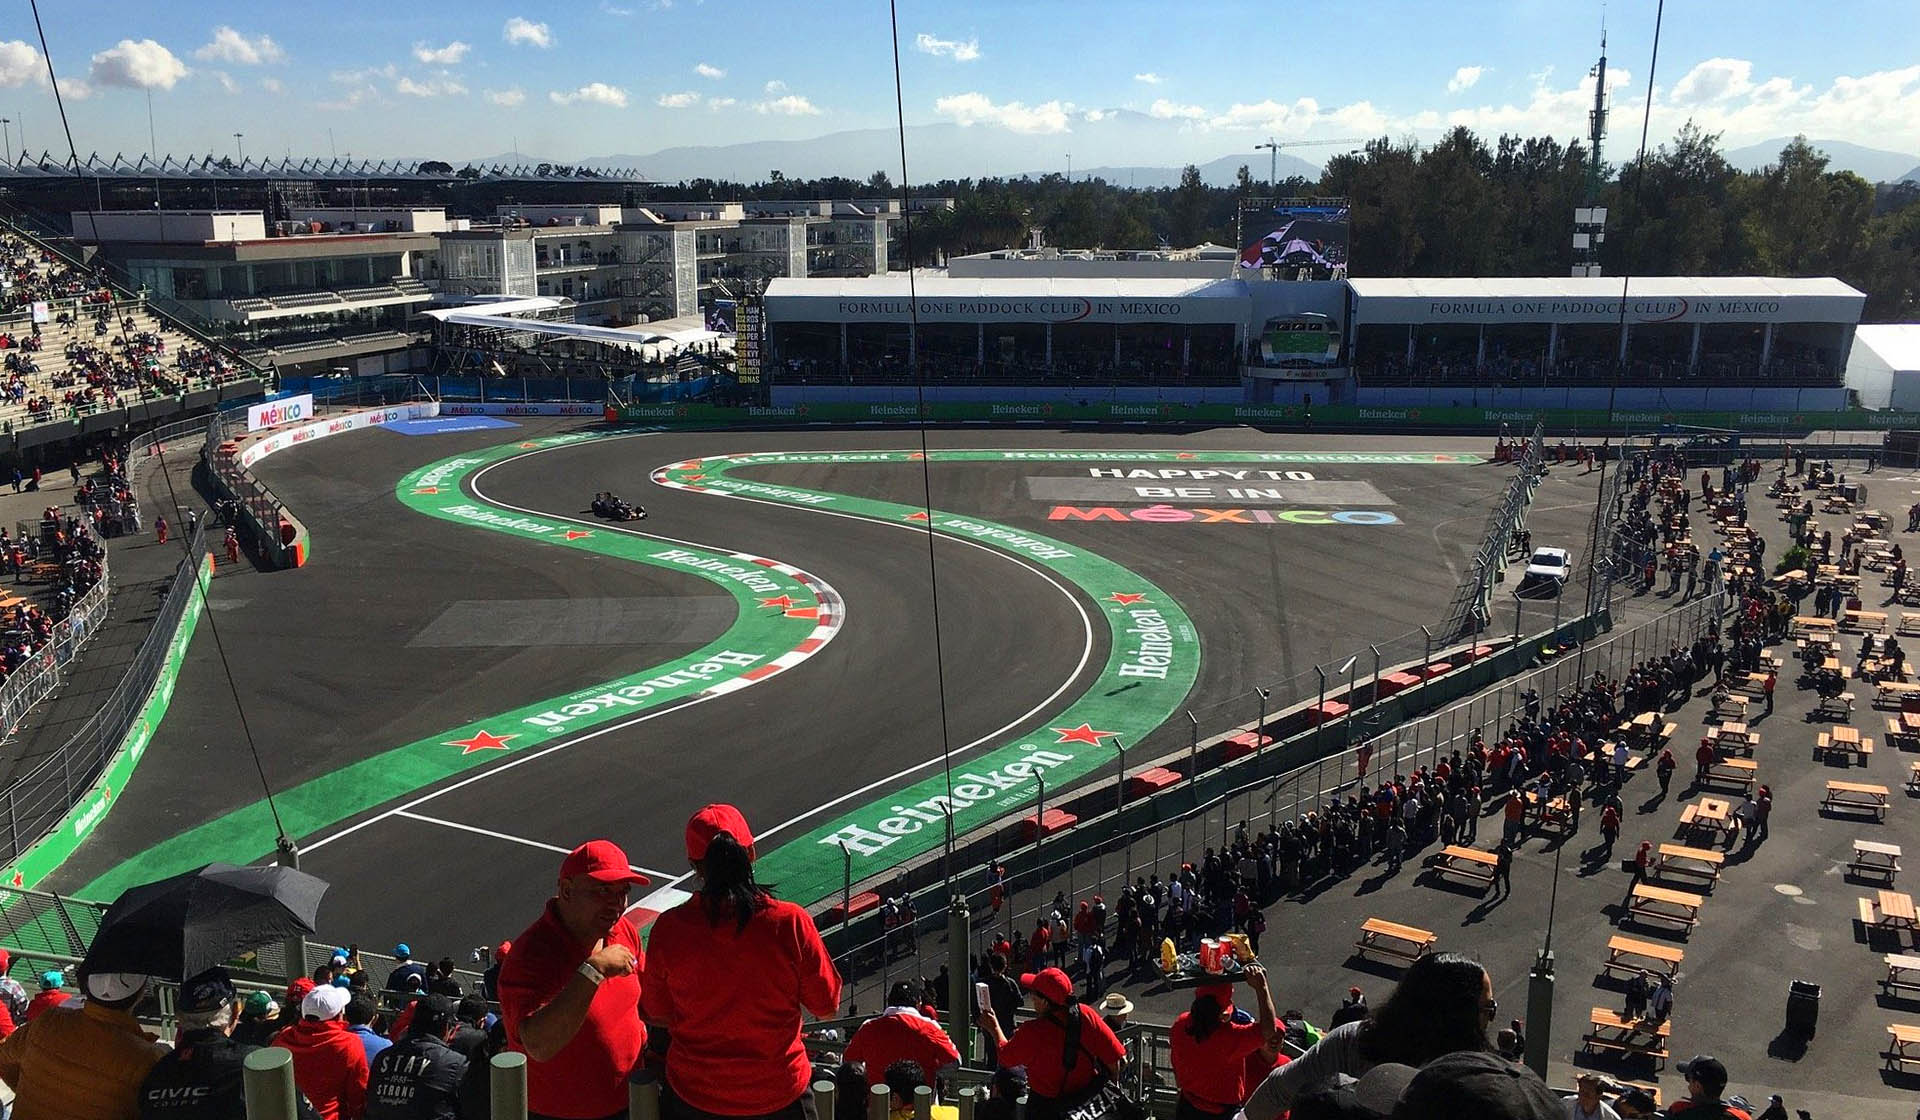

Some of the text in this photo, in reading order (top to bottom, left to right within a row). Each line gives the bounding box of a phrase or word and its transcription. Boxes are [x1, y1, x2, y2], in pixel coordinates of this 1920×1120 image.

[839, 302, 914, 314] FORMULA
[921, 302, 952, 314] ONE
[959, 302, 1033, 314] PADDOCK
[1040, 302, 1081, 314] CLUB
[1097, 302, 1113, 314] IN
[1430, 302, 1505, 314] FORMULA
[1512, 302, 1545, 314] ONE
[1552, 302, 1628, 314] PADDOCK
[1634, 302, 1676, 314] CLUB
[1695, 302, 1711, 313] IN
[748, 376, 760, 384] NAS
[628, 406, 674, 417] Heineken
[750, 406, 795, 416] Heineken
[870, 405, 917, 415] Heineken
[992, 404, 1039, 414] Heineken
[1111, 405, 1158, 415] Heineken
[1235, 407, 1282, 417] Heineken
[1359, 409, 1406, 419] Heineken
[1740, 414, 1789, 424] Heineken
[728, 453, 890, 464] Heineken
[1089, 468, 1315, 481] HAPPY TO
[1135, 486, 1283, 499] BE IN
[439, 504, 554, 534] Heineken
[943, 520, 1077, 560] Heineken
[648, 549, 781, 593] Heineken
[1118, 608, 1172, 680] Heineken
[522, 650, 766, 726] Heineken
[818, 748, 1074, 857] Heineken
[380, 1055, 432, 1076] STAY
[148, 1086, 209, 1100] CIVIC
[376, 1084, 415, 1098] STRONG
